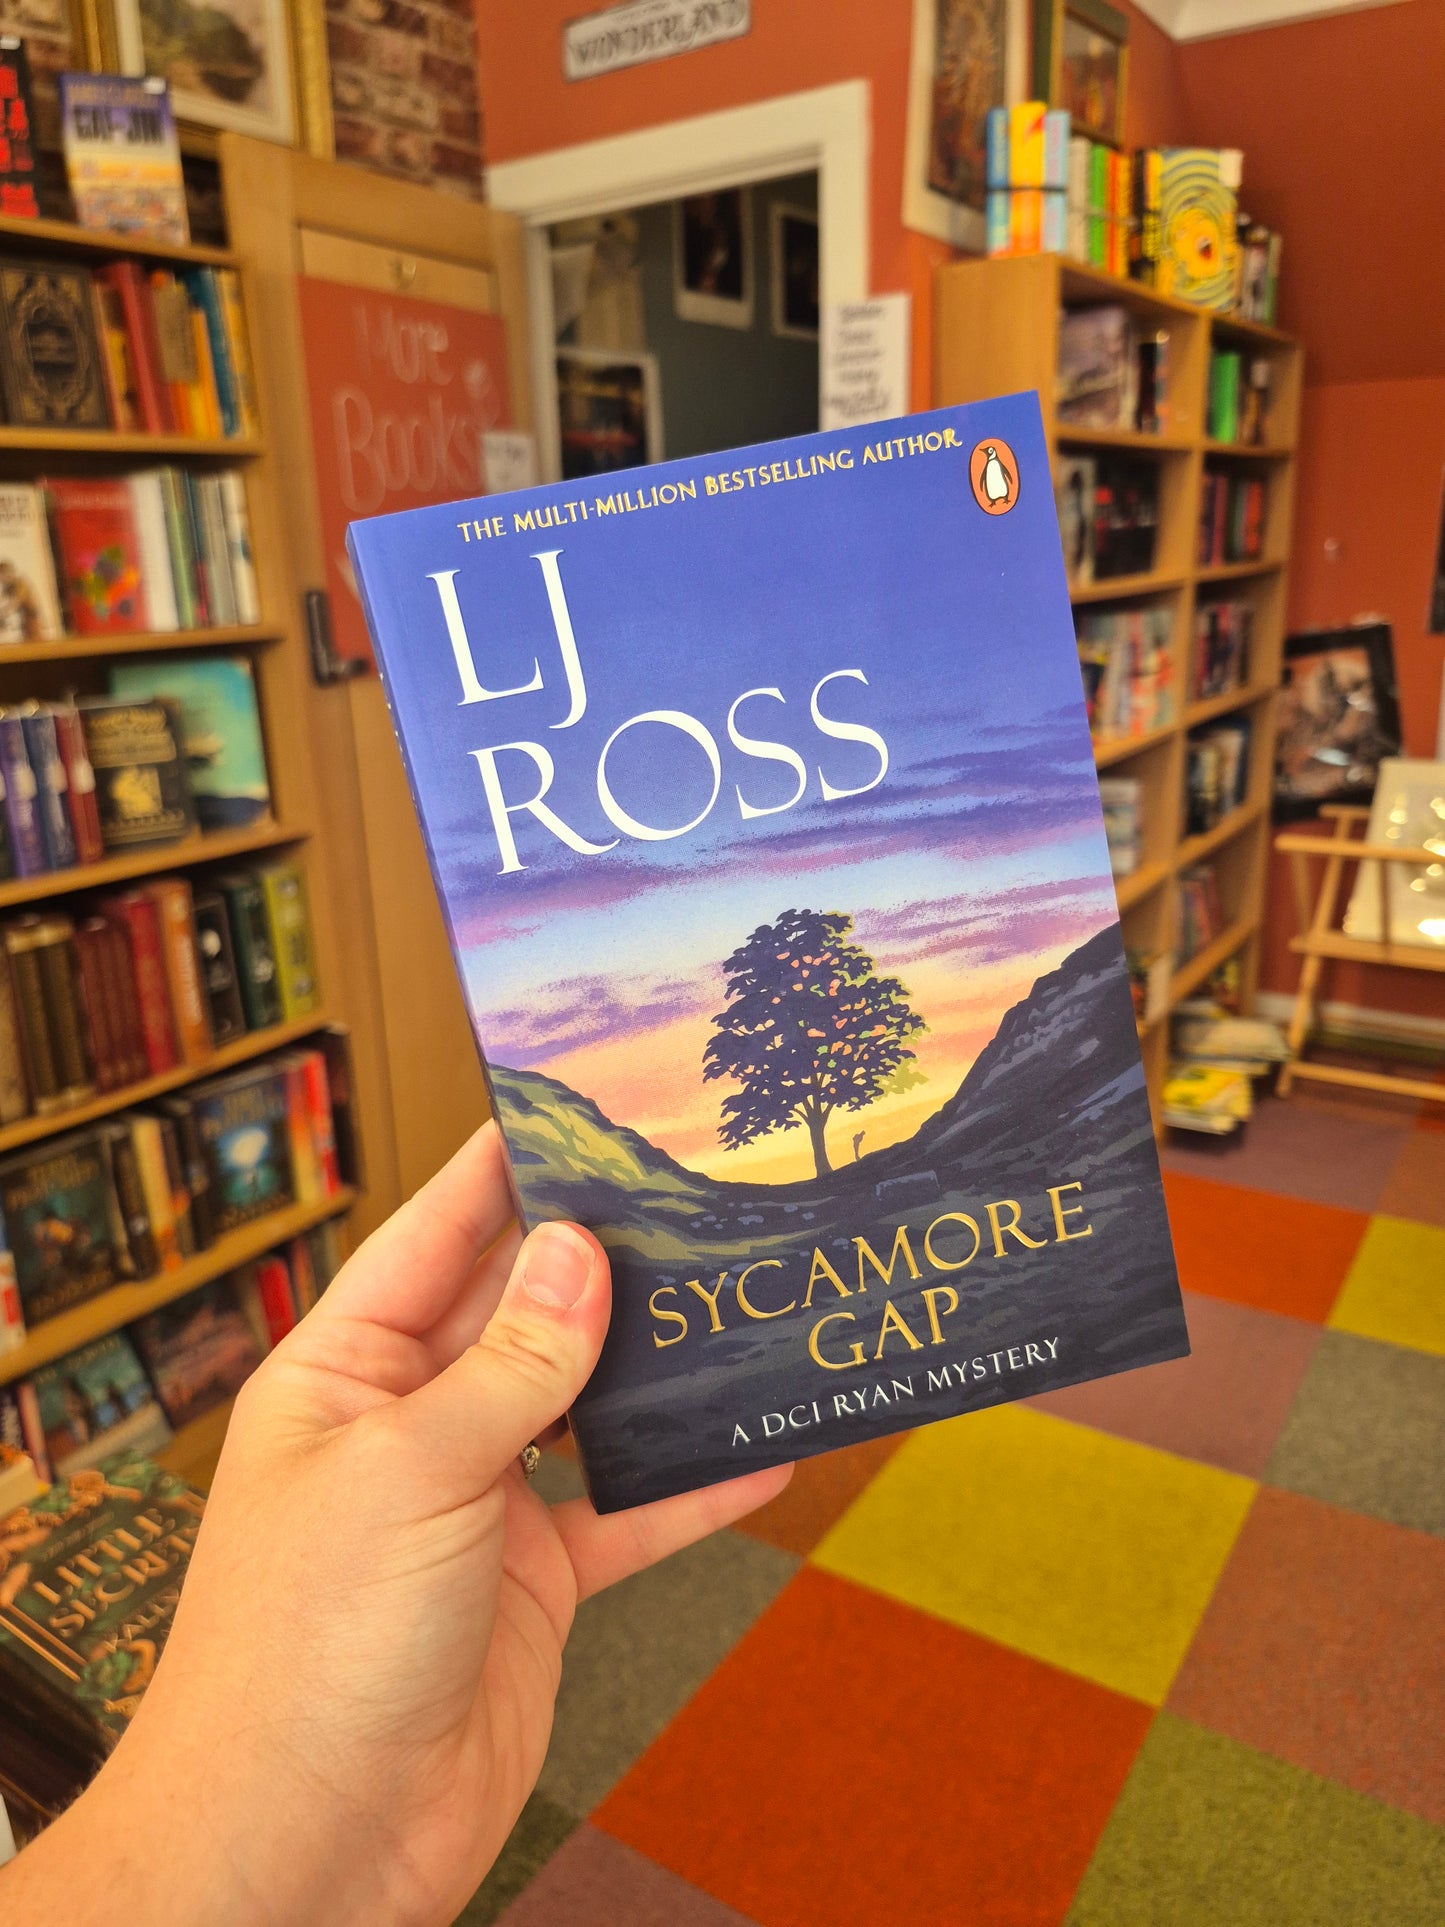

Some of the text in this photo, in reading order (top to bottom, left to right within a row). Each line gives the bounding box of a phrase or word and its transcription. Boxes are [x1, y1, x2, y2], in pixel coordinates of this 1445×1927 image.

[456, 427, 963, 543] THE MULTI-MILLION BESTSELLING AUTHOR
[425, 549, 587, 730] LJ
[466, 669, 889, 876] ROSS
[648, 1181, 1093, 1349] SYCAMORE
[808, 1286, 959, 1370] GAP
[731, 1336, 1060, 1447] A DCI RYAN MYSTERY
[33, 1508, 176, 1606] LITTLE
